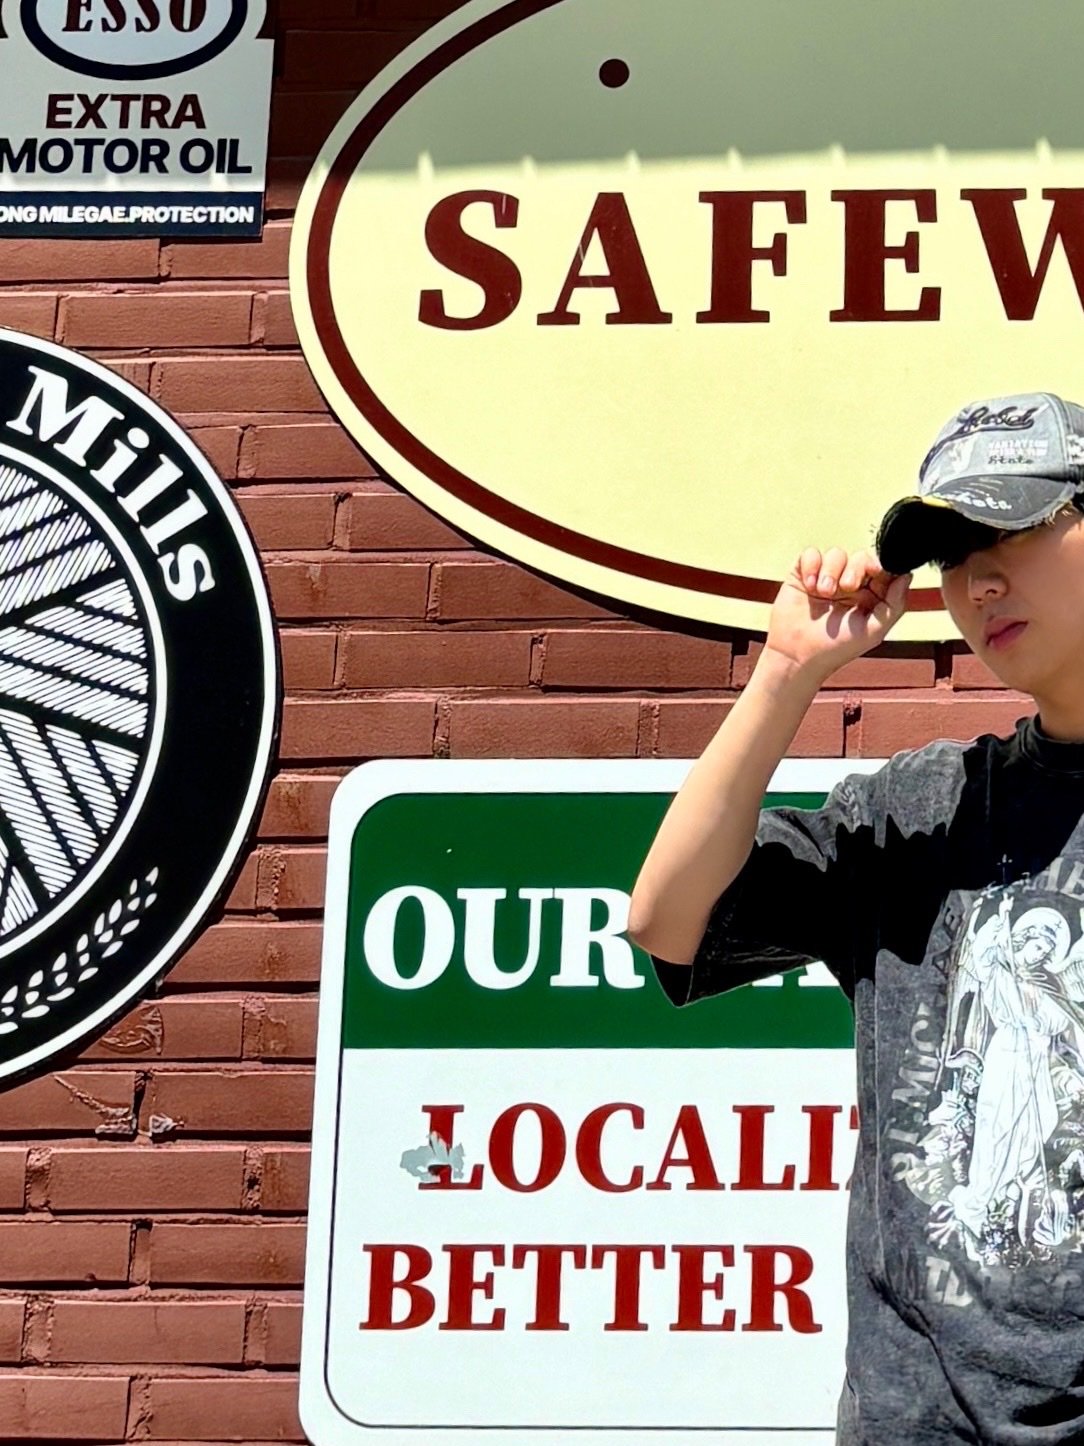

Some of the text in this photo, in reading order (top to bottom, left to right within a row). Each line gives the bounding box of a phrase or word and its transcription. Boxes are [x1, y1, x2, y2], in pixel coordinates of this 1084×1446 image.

[0, 138, 252, 174] MOTOR OIL
[46, 93, 206, 129] EXTRA
[6, 365, 216, 602] Mills
[364, 885, 646, 991] OUR
[418, 1102, 859, 1193] LOCALI
[359, 1243, 823, 1334] BETTER
